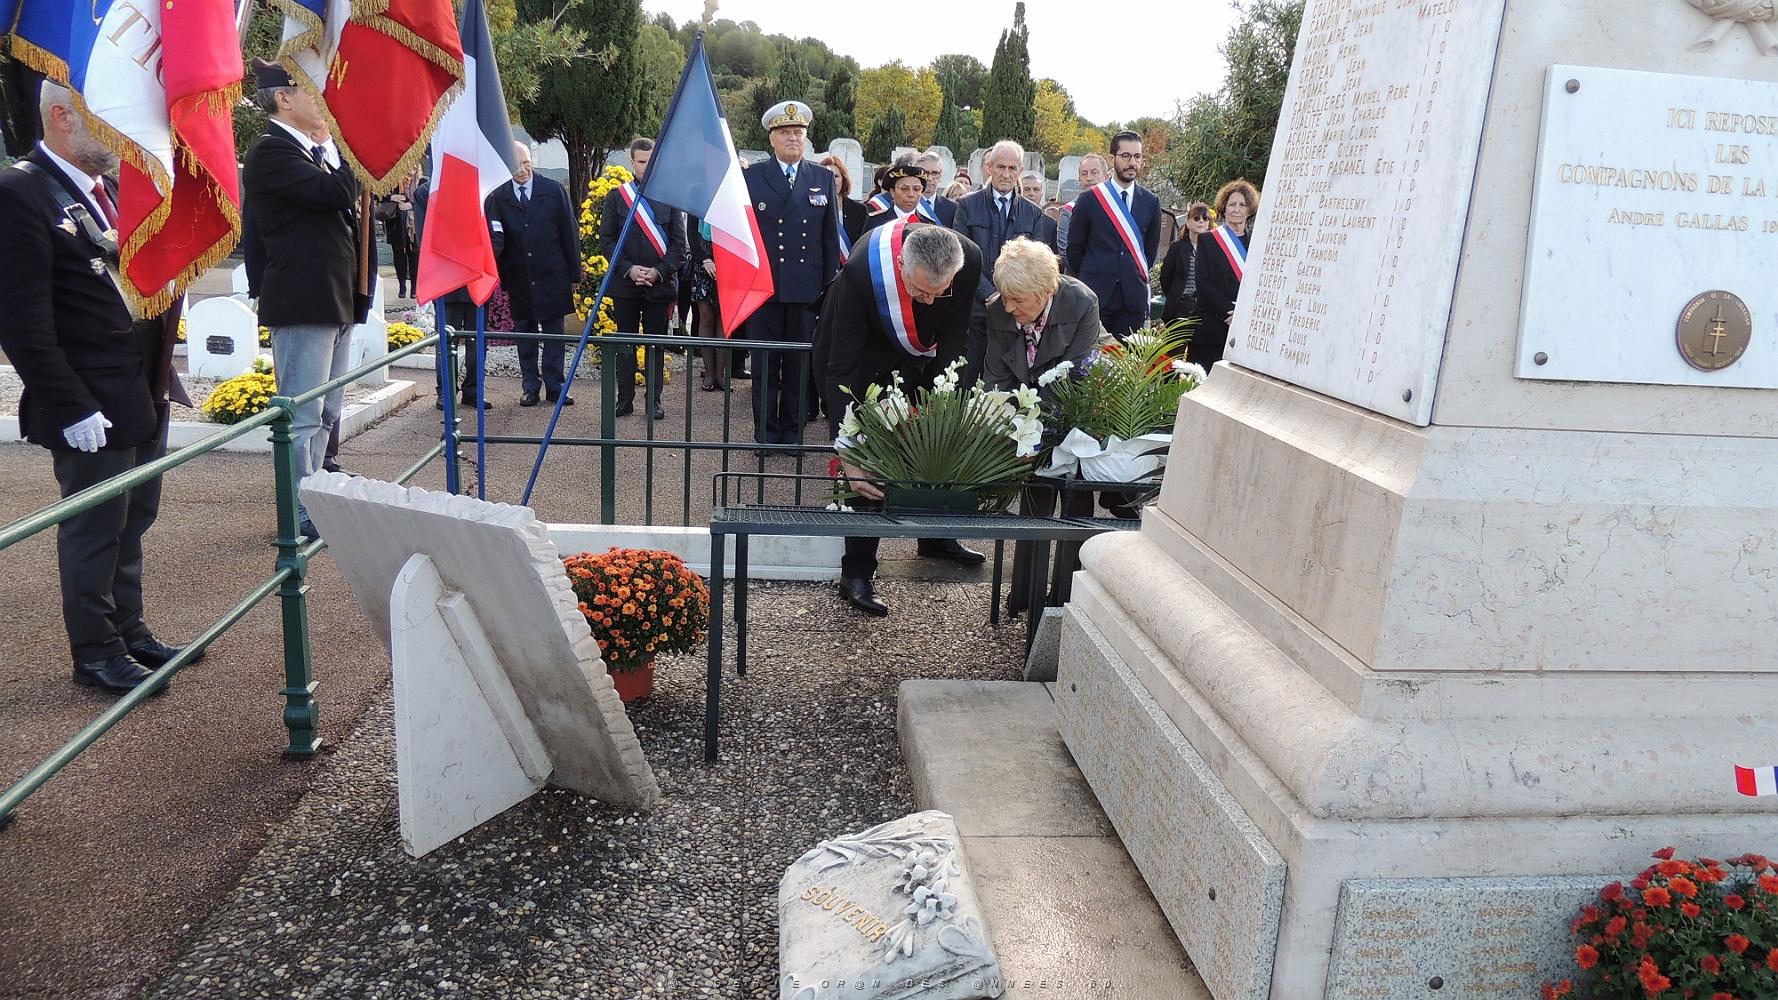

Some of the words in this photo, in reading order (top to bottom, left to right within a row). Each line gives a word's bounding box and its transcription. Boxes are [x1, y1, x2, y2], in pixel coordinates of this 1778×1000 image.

[1353, 22, 1374, 38] JEAN
[1347, 59, 1366, 74] JEAN
[1297, 81, 1329, 99] THOMAS
[1343, 77, 1361, 91] JEAN
[1352, 90, 1381, 106] MICHEL
[1327, 111, 1345, 126] JEAN
[1352, 106, 1387, 122] CHARLES
[1666, 107, 1696, 130] ICI
[1349, 125, 1379, 141] CLAUDE
[1715, 143, 1750, 166] LES
[1306, 179, 1333, 193] JOSEPH
[1557, 163, 1699, 193] COMPAGNONS
[1706, 174, 1734, 195] DE
[1742, 177, 1767, 198] LA
[1274, 194, 1309, 210] LAURENT
[1319, 194, 1366, 212] BARTHELEMY
[1319, 211, 1338, 227] JEAN
[1341, 212, 1377, 230] LAURENT
[1674, 211, 1749, 232] GALLAS
[1315, 228, 1348, 246] SAUVEUR
[1295, 279, 1322, 297] JOSEPH
[1307, 297, 1329, 316] LOUIS
[1246, 334, 1270, 354] SOLEIL
[1288, 328, 1308, 347] LOUIS
[800, 885, 890, 944] SOUVENIR
